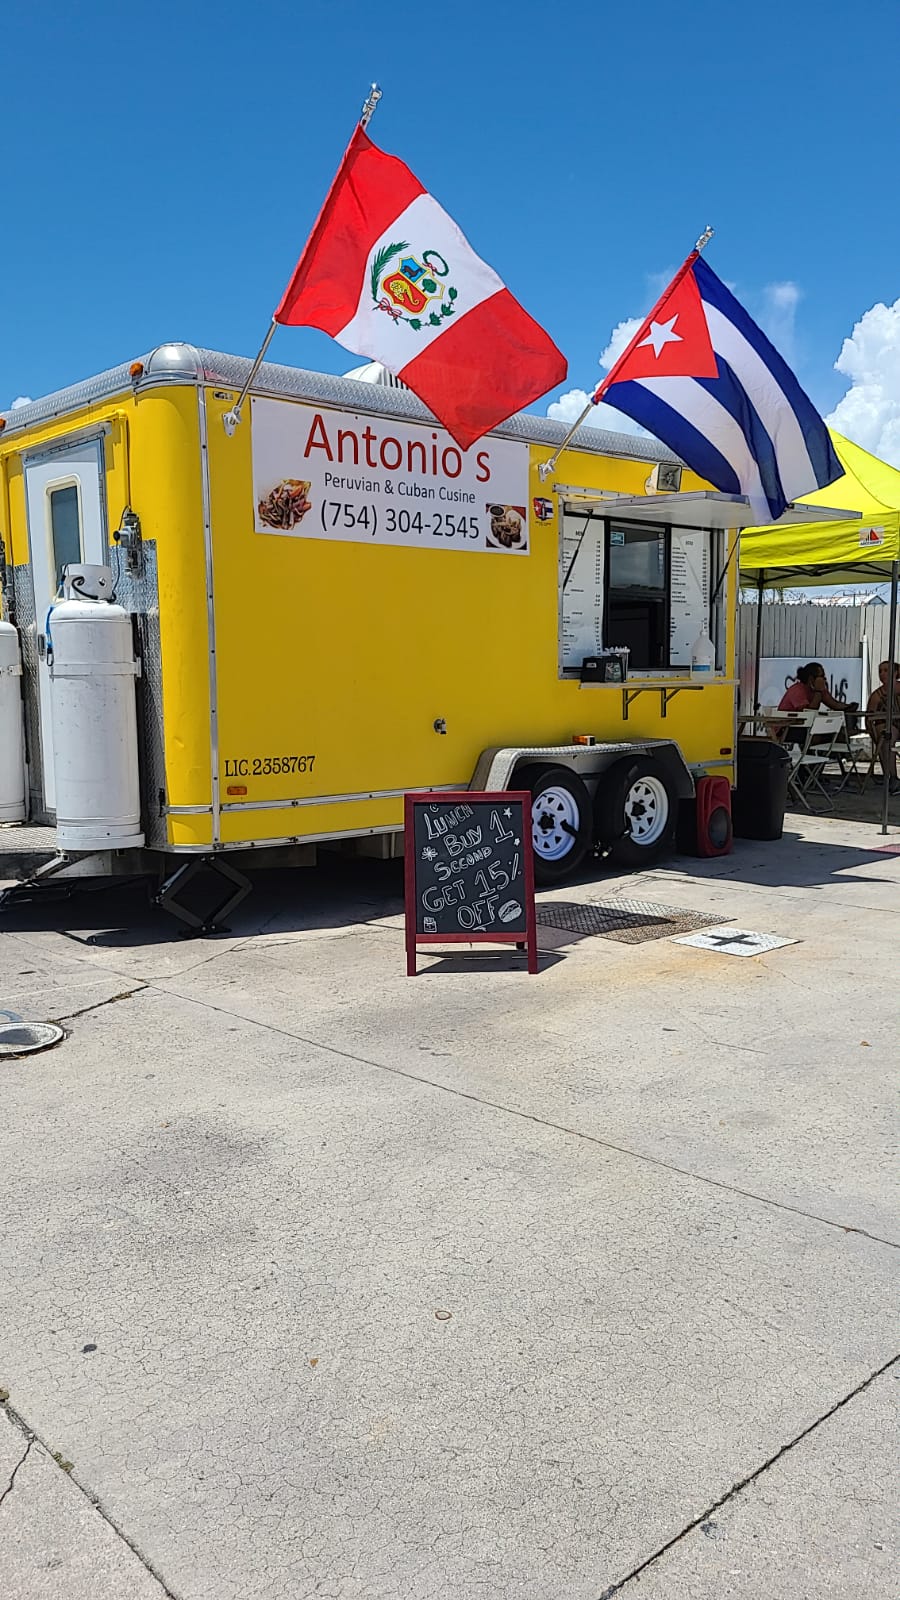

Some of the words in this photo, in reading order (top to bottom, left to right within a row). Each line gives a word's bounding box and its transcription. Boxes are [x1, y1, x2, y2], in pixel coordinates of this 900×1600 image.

[304, 414, 491, 482] Antonios
[324, 472, 380, 492] Peruvian
[384, 480, 394, 494] &
[398, 482, 435, 499] Cuban
[439, 487, 476, 503] Cusine
[321, 499, 378, 536] (754)
[385, 508, 480, 539] 304-2545
[225, 755, 315, 776] LIC.2358767
[423, 804, 474, 840] LUNCH
[490, 809, 514, 844] 1
[422, 879, 466, 912] GET
[475, 853, 522, 898] 15%
[457, 894, 499, 929] OFF
